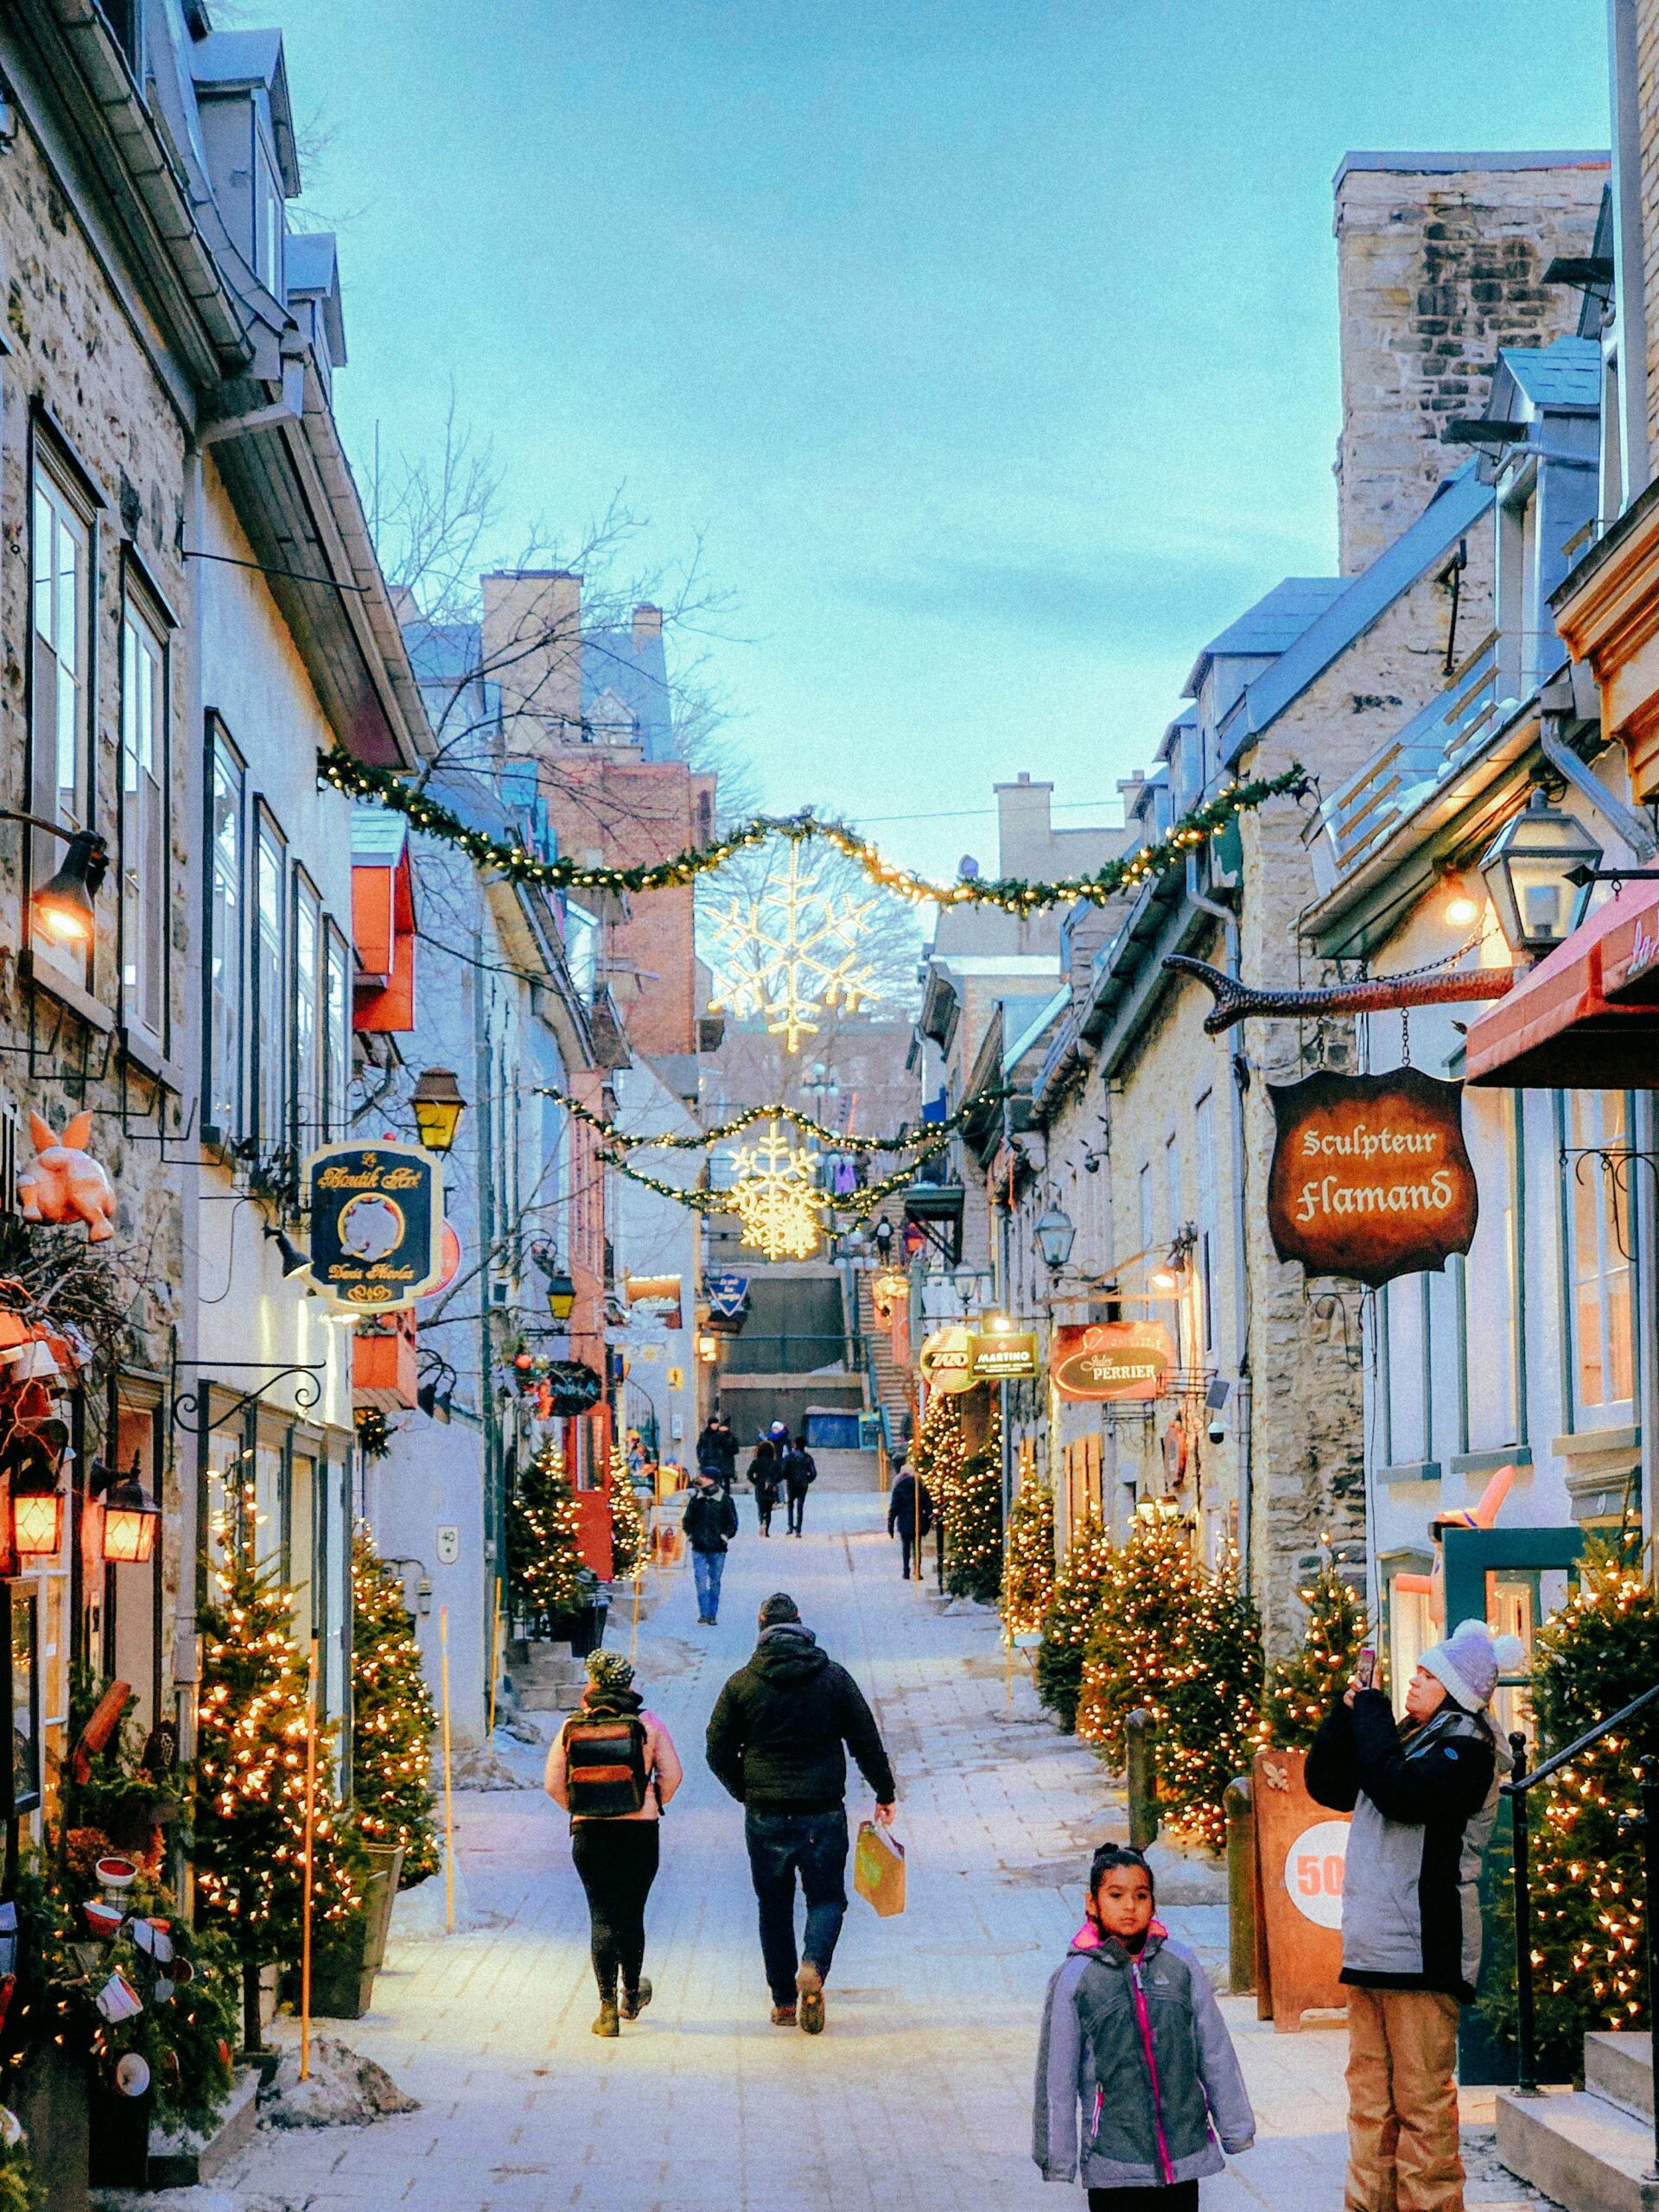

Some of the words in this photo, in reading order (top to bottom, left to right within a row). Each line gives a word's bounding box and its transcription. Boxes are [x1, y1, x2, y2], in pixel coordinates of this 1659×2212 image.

[1301, 1124, 1437, 1160] Sculpteur
[1296, 1170, 1452, 1223] Flamand
[977, 1351, 1030, 1363] MARTINO
[1093, 1364, 1157, 1382] PERRIER
[441, 1531, 455, 1542] 40
[1296, 1854, 1345, 1897] 50
